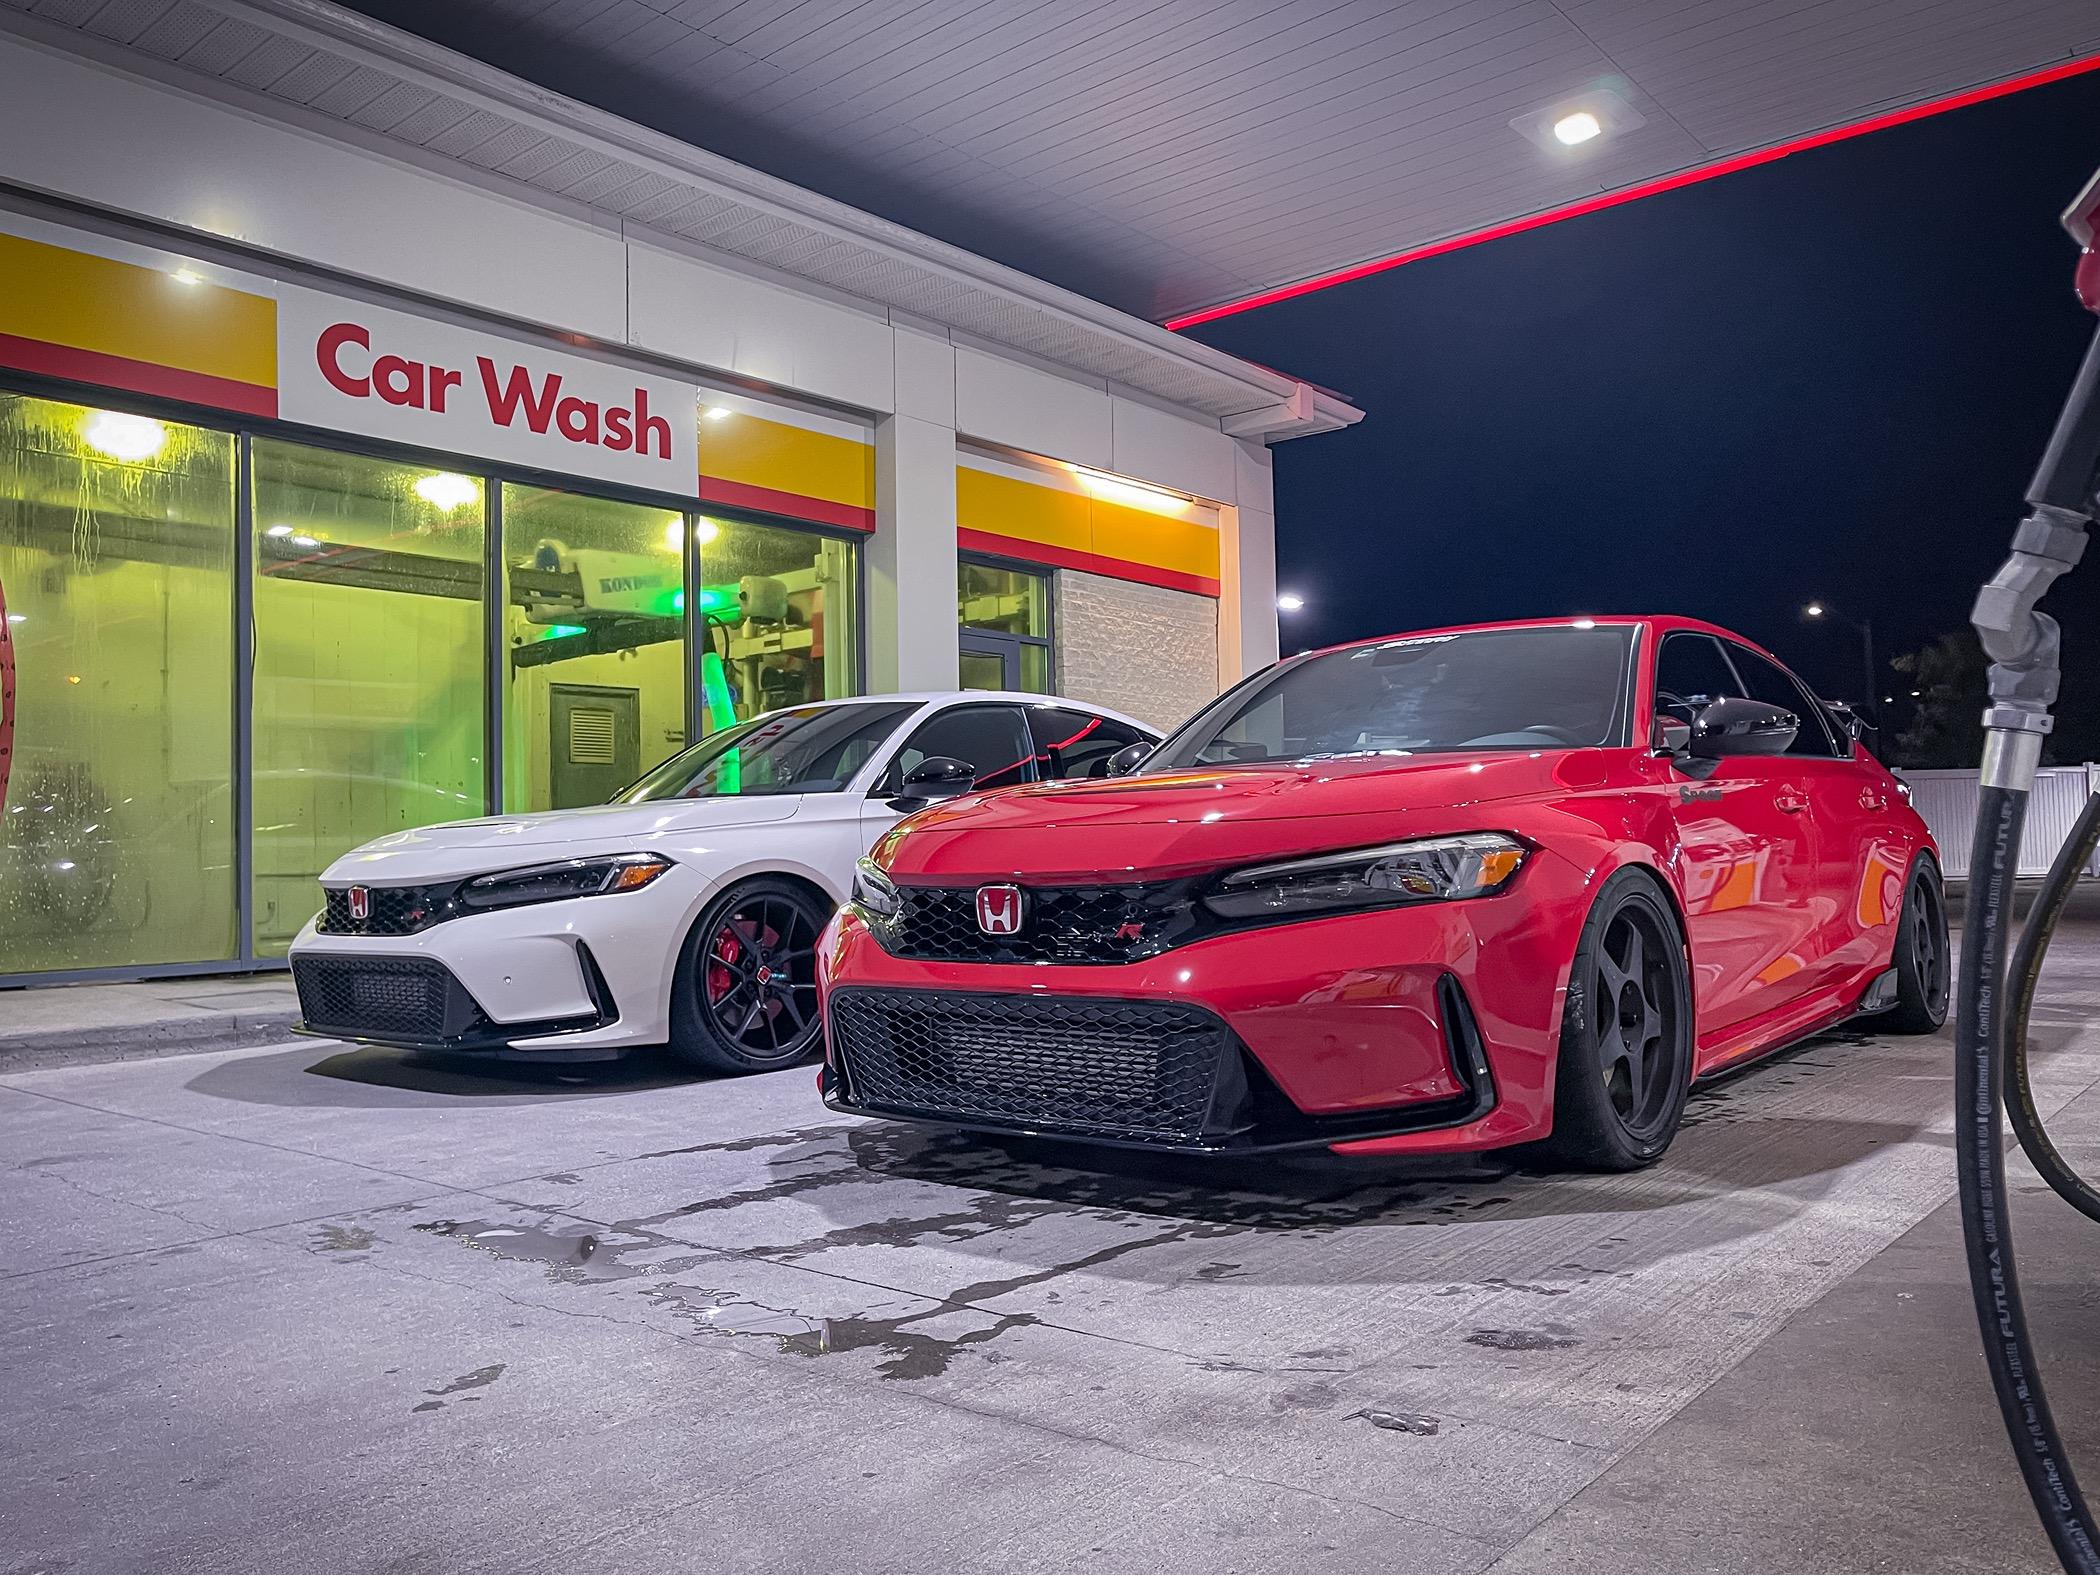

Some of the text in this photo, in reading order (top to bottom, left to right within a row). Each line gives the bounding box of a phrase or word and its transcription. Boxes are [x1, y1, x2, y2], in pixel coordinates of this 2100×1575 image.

[315, 322, 673, 461] Car Wash
[1976, 985, 1992, 1038] ContiTech
[1975, 1055, 1992, 1115] Continental
[1977, 1124, 1989, 1138] USA
[1977, 1139, 1989, 1147] IN
[1978, 1149, 1990, 1168] MADE
[1983, 1208, 1999, 1242] GASOLINE
[1988, 1247, 2015, 1338] FUTURA
